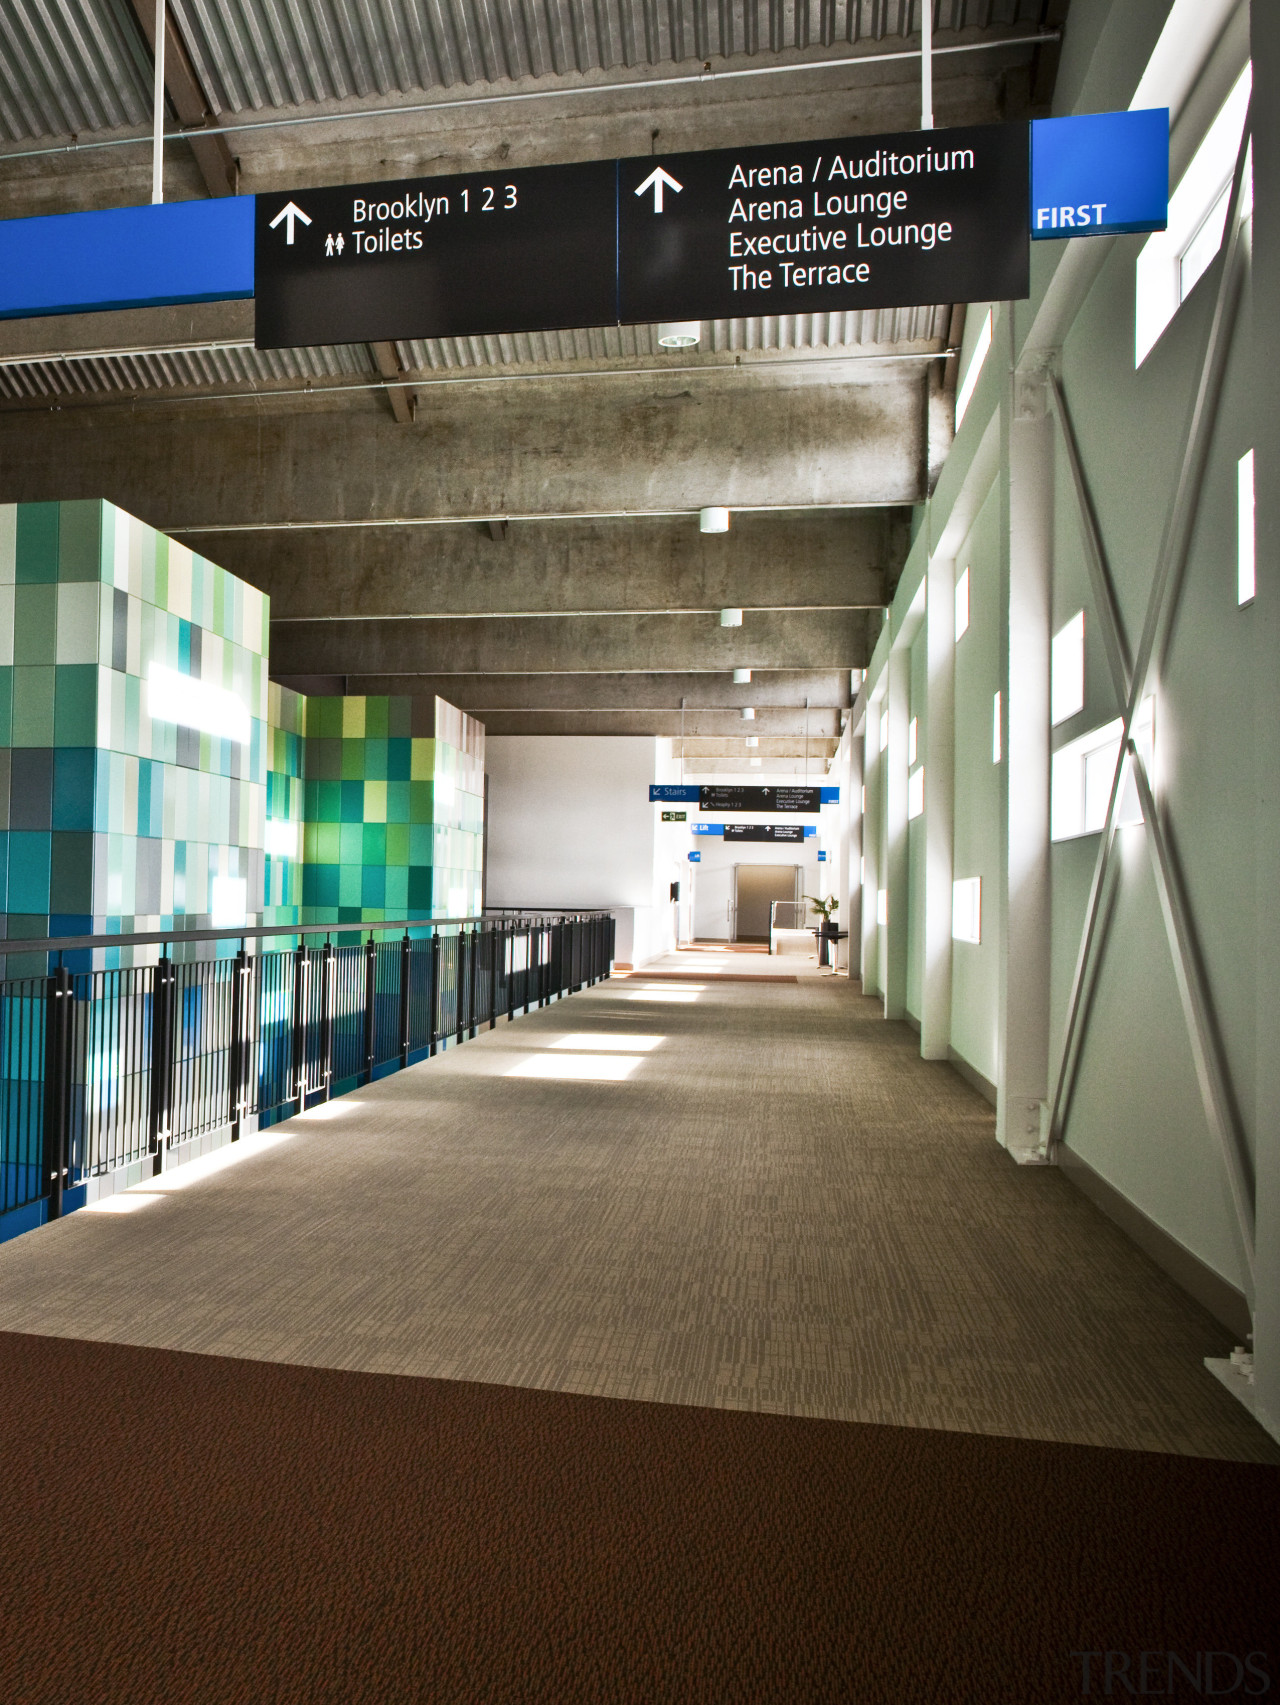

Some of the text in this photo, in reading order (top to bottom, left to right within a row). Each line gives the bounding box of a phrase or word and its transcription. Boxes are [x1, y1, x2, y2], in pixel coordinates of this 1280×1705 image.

[728, 146, 974, 189] Arena / Auditorium
[353, 185, 517, 222] Brooklyn 1 2 3
[728, 190, 907, 223] Arena Lounge
[1037, 203, 1107, 229] FIRST
[352, 227, 423, 254] Toilets
[729, 221, 952, 257] Executive Lounge
[728, 263, 869, 291] The Terrace
[664, 787, 687, 796] Stairs
